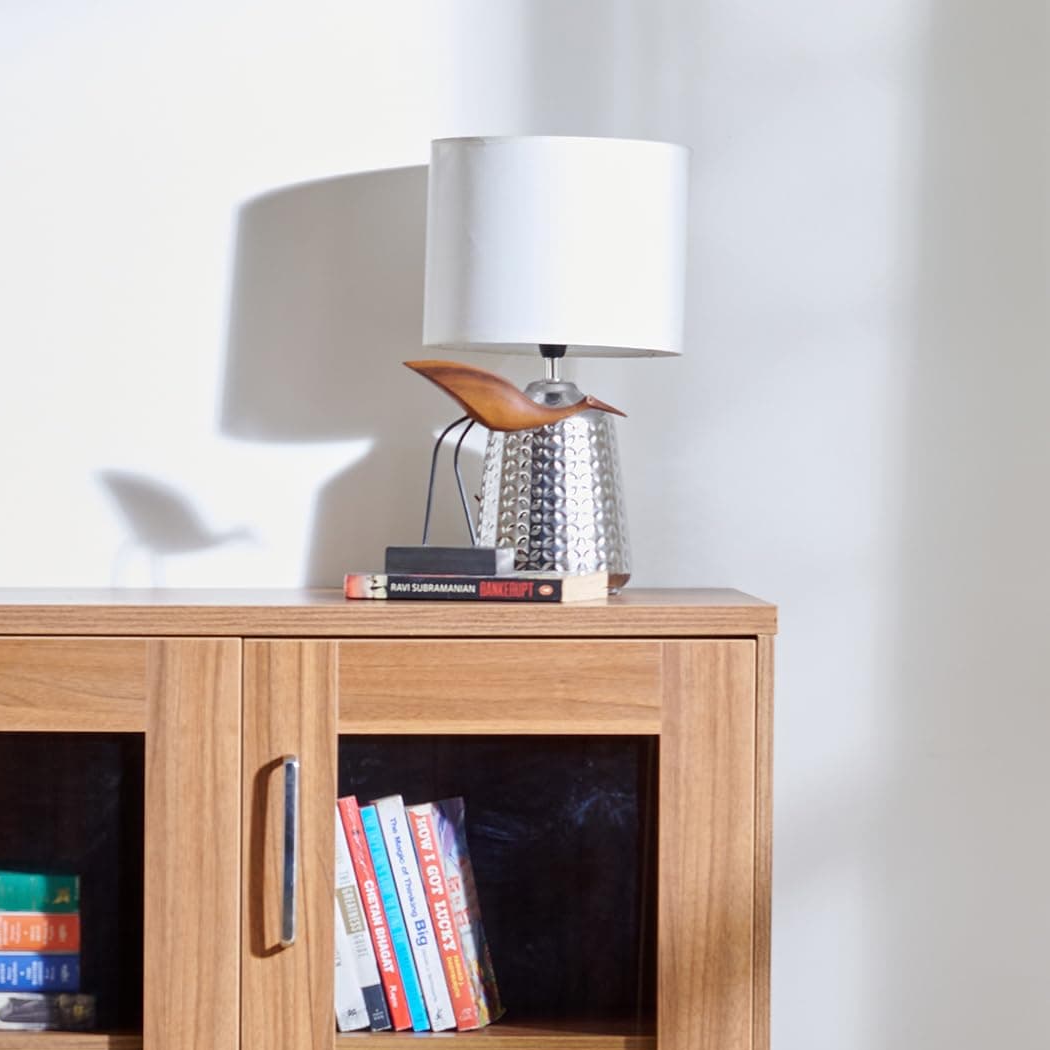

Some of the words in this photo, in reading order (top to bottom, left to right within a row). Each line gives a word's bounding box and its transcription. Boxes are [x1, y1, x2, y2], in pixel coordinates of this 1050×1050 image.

[390, 582, 411, 593] RAVI
[411, 583, 476, 594] SUBRAMANIAN
[390, 817, 398, 835] The
[416, 817, 434, 852] HOW
[394, 835, 406, 866] Magic
[423, 852, 436, 862] I
[401, 865, 410, 878] of
[425, 864, 444, 896] GOT
[403, 876, 419, 918] Thinking
[363, 879, 384, 929] CHETAN
[374, 929, 394, 974] BHAGAT
[414, 919, 428, 947] Big
[434, 900, 457, 952] LUCKY
